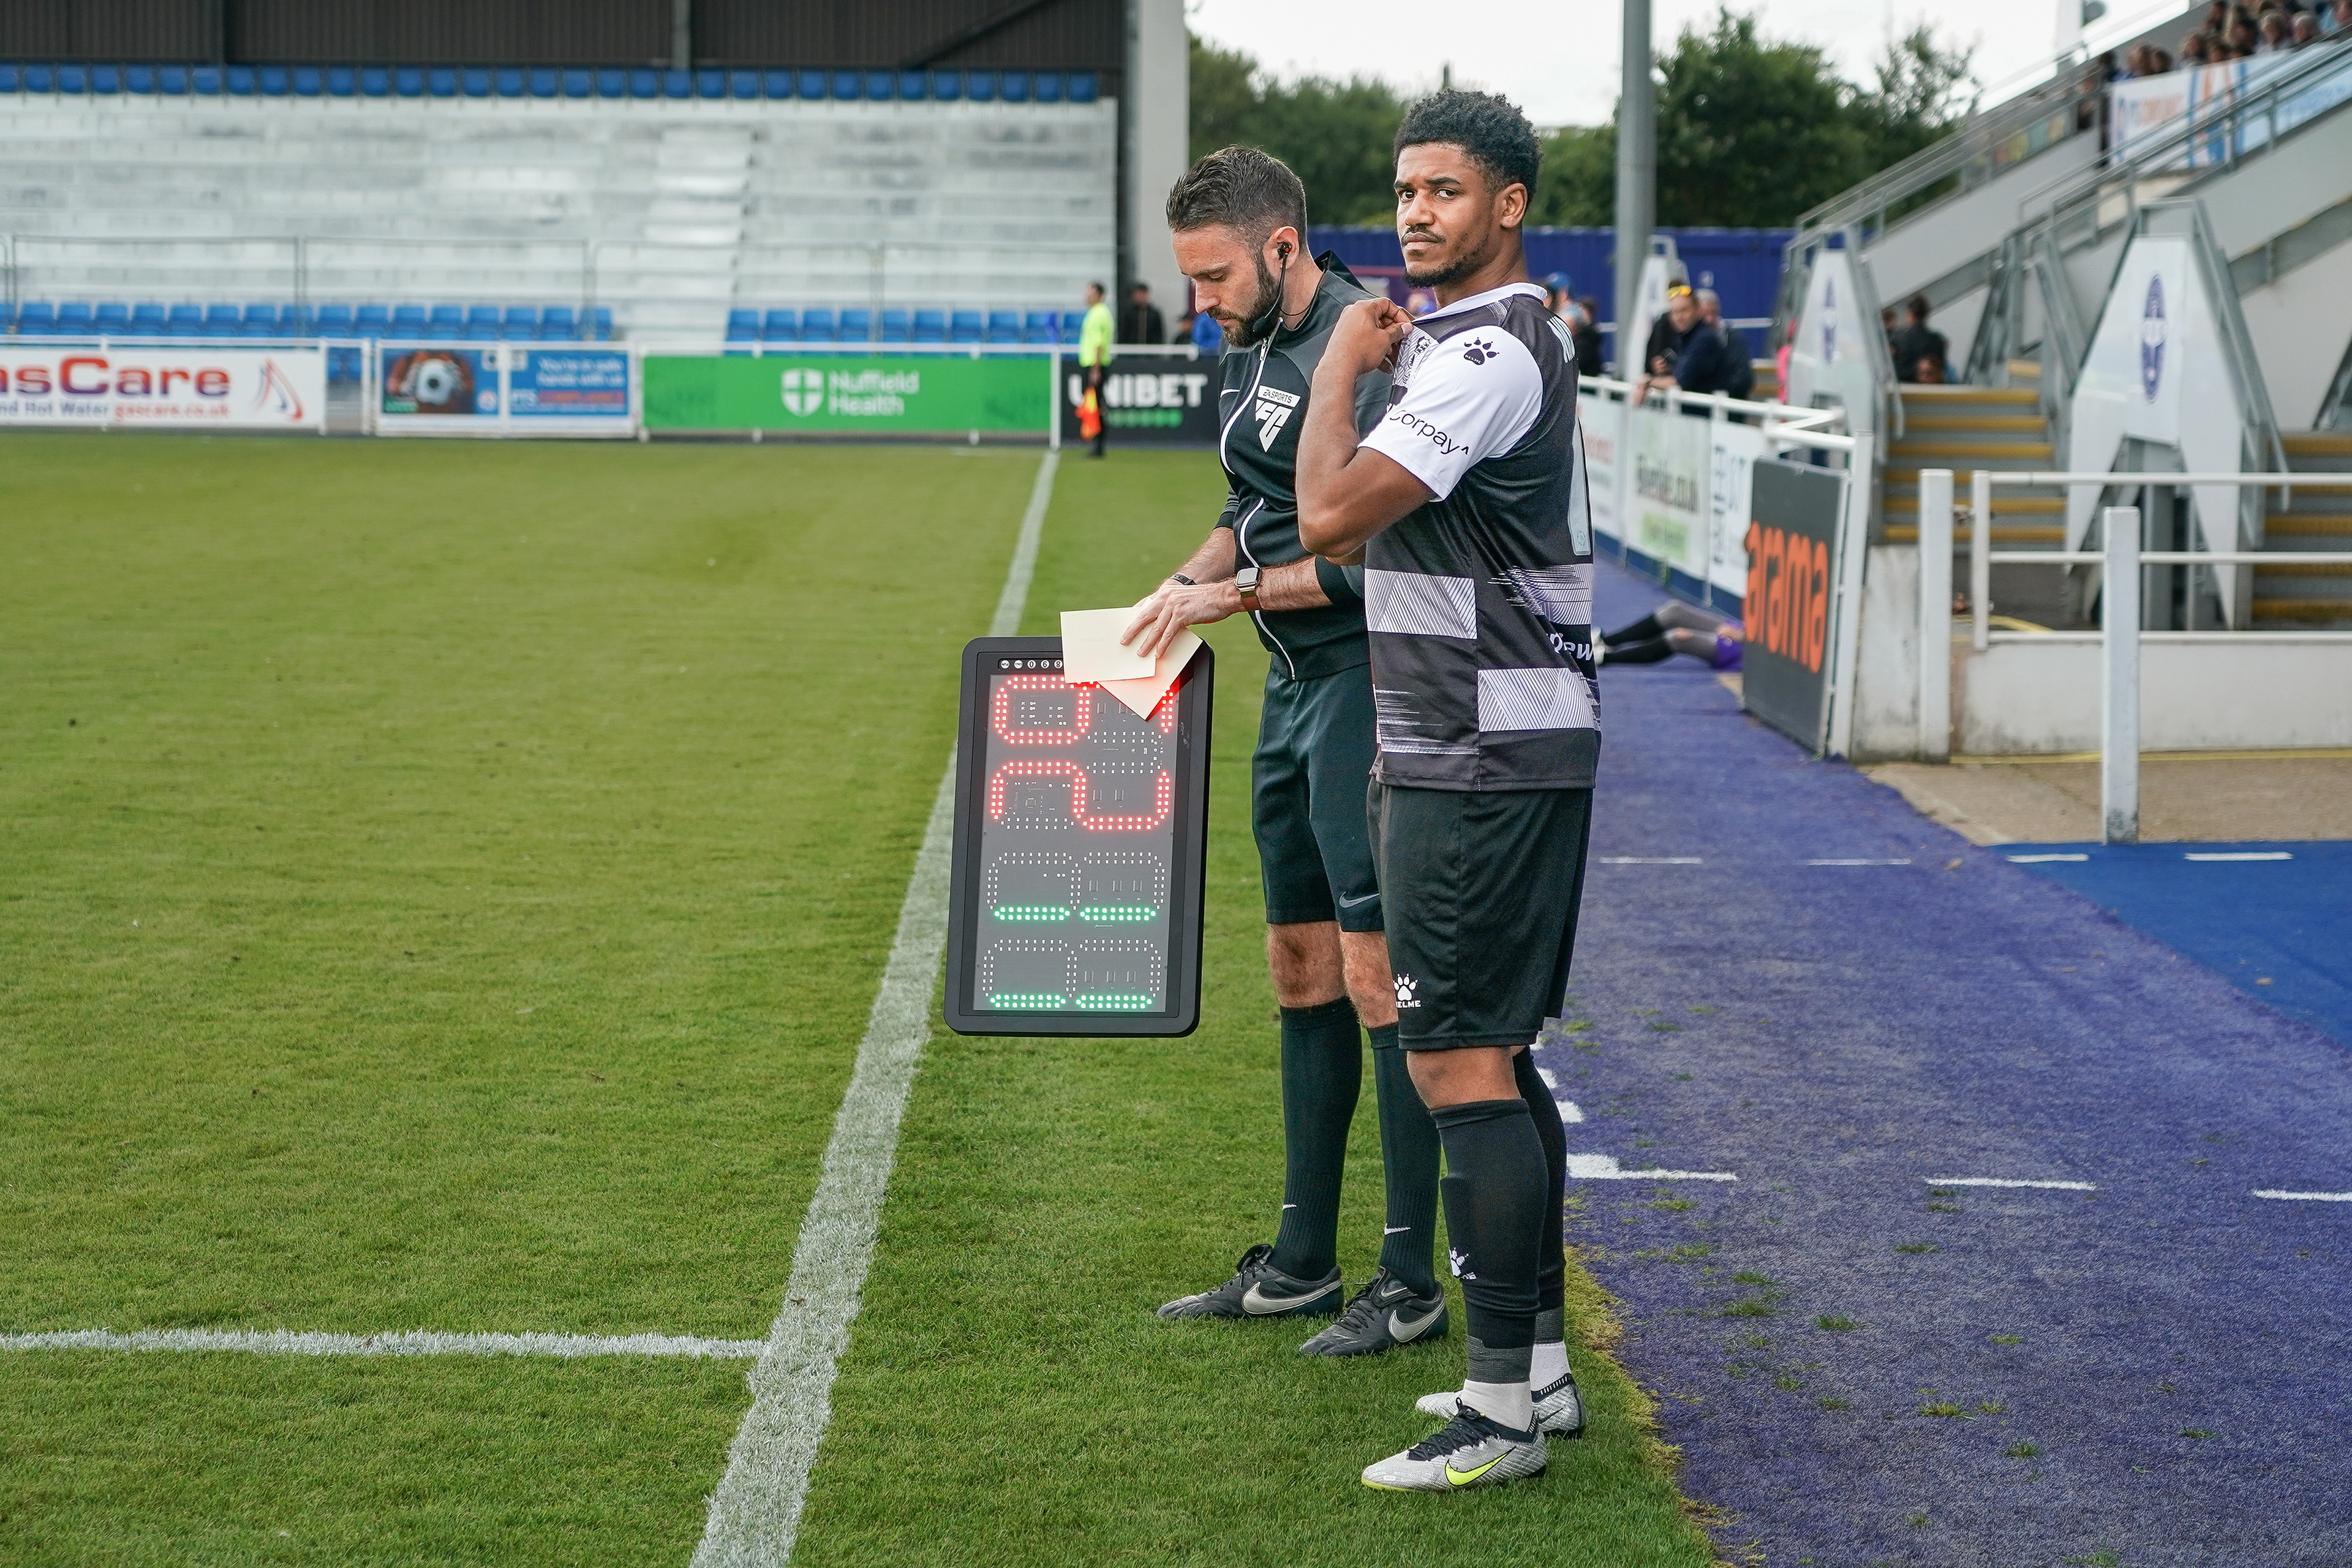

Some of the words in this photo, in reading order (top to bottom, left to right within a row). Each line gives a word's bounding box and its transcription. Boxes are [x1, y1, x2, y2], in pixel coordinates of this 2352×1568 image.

[829, 369, 919, 394] Nuffield
[61, 402, 109, 418] Water
[829, 394, 905, 417] Health
